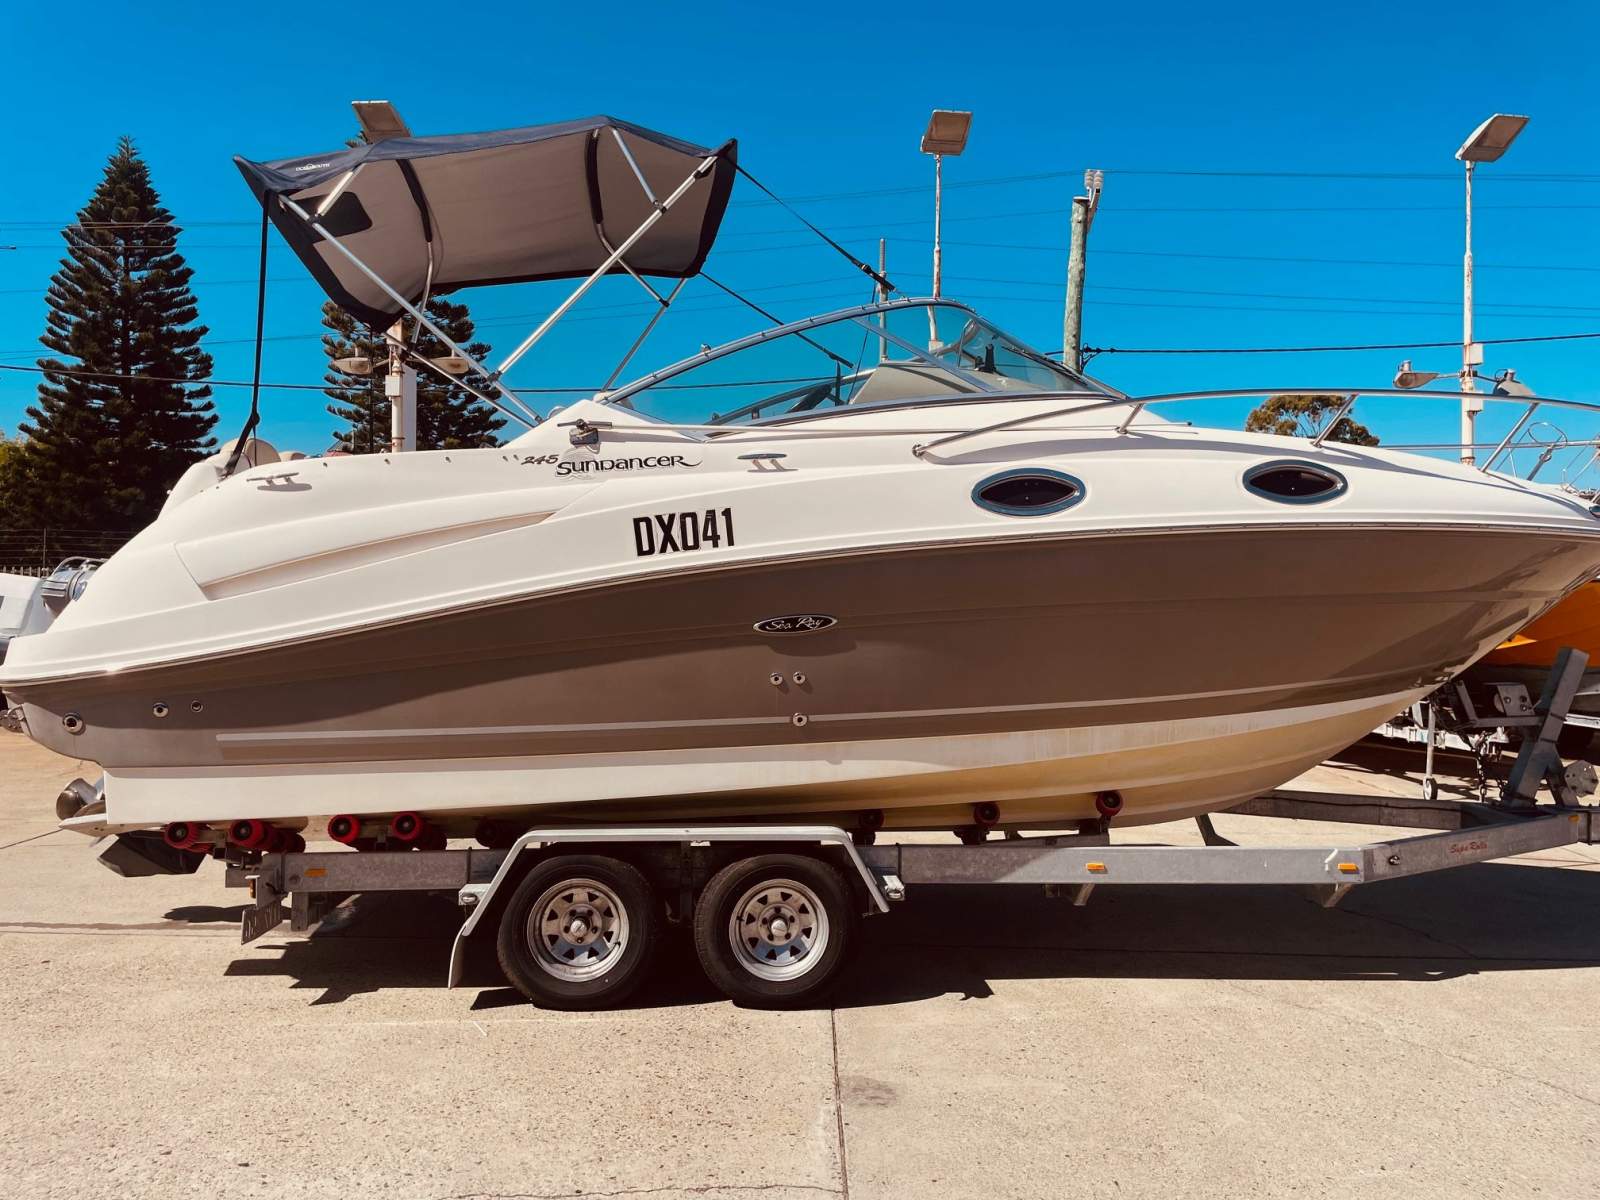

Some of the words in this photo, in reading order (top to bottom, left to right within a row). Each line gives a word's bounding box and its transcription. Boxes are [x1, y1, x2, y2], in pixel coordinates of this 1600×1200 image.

[521, 454, 559, 465] 245
[633, 507, 735, 556] DX041
[765, 620, 792, 630] Sea
[796, 616, 824, 630] Ray
